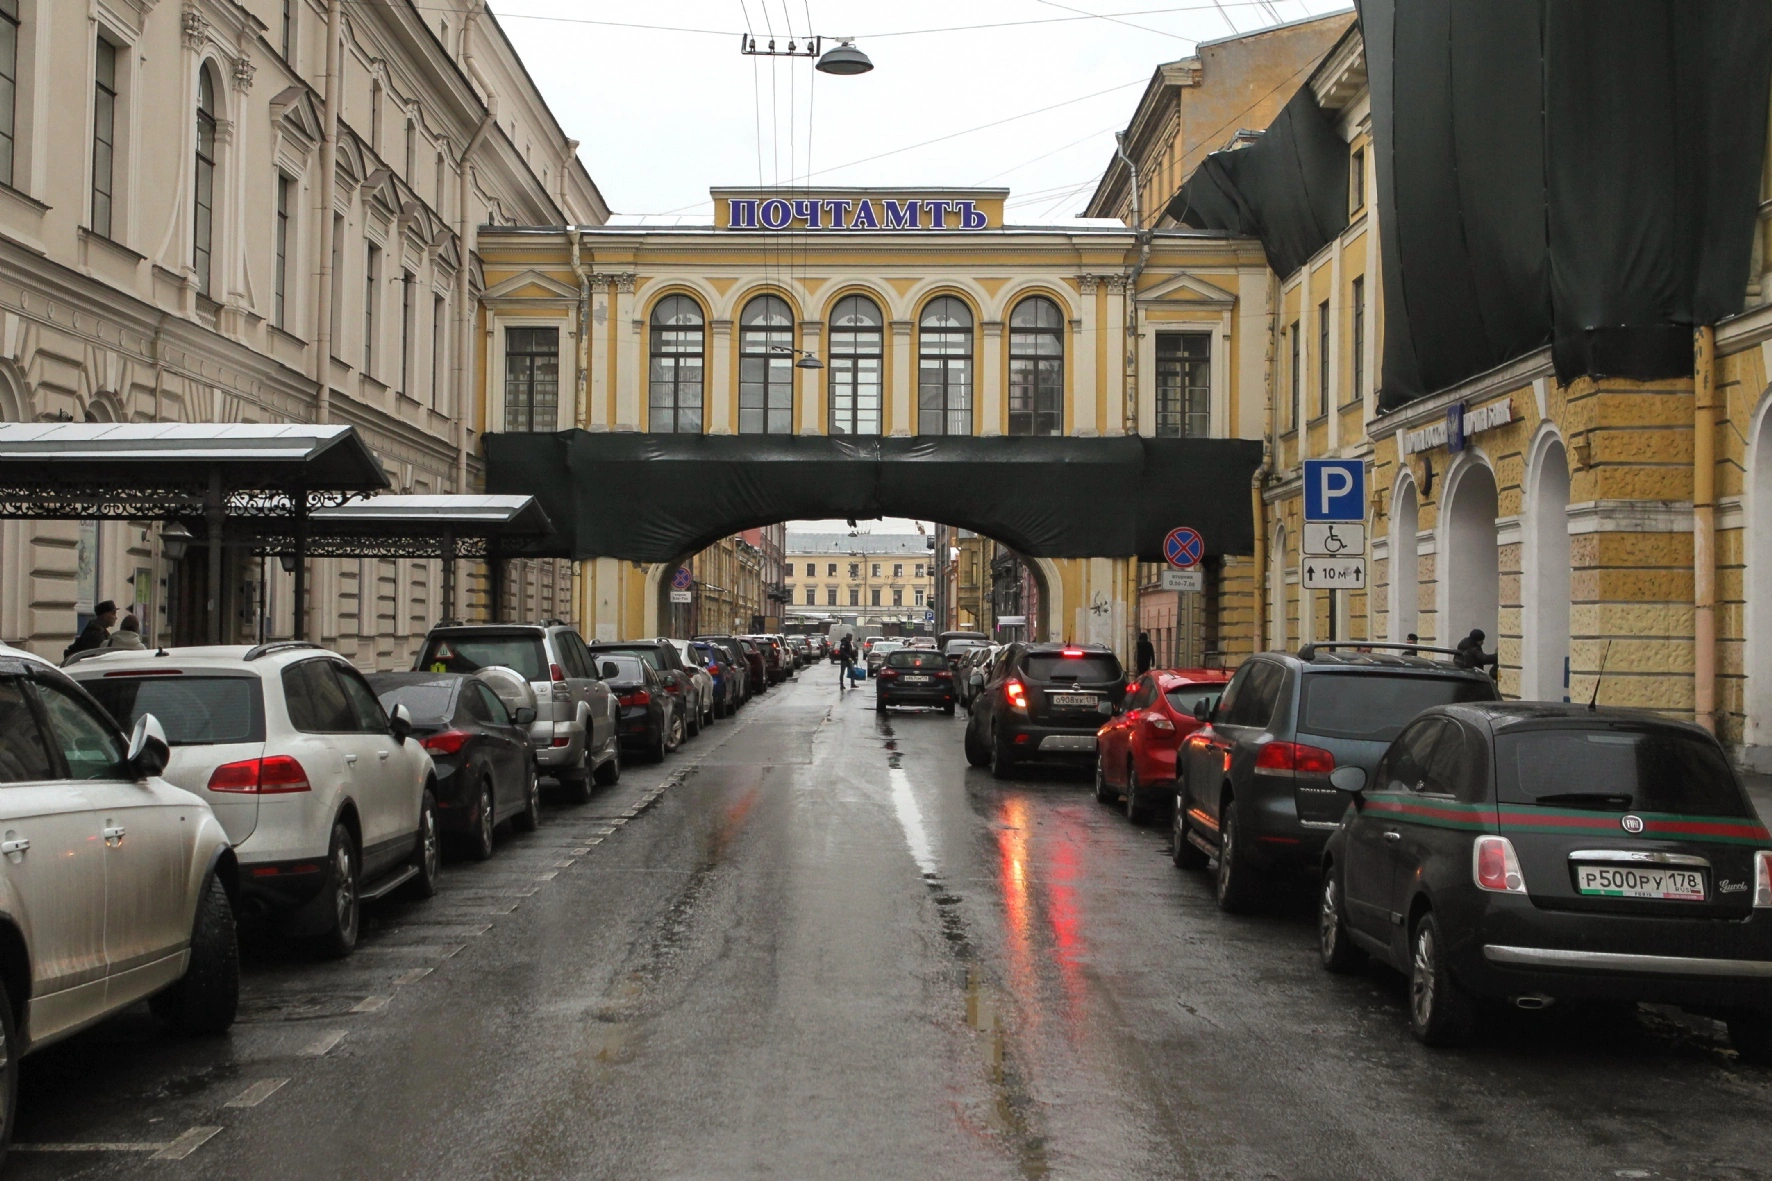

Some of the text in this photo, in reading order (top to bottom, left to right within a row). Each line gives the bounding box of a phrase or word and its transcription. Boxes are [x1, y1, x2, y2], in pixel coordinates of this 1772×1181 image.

[728, 199, 987, 229] ПОЧТАМТЪ
[1321, 467, 1353, 514] P
[1322, 568, 1336, 579] 10
[1668, 872, 1697, 888] 178
